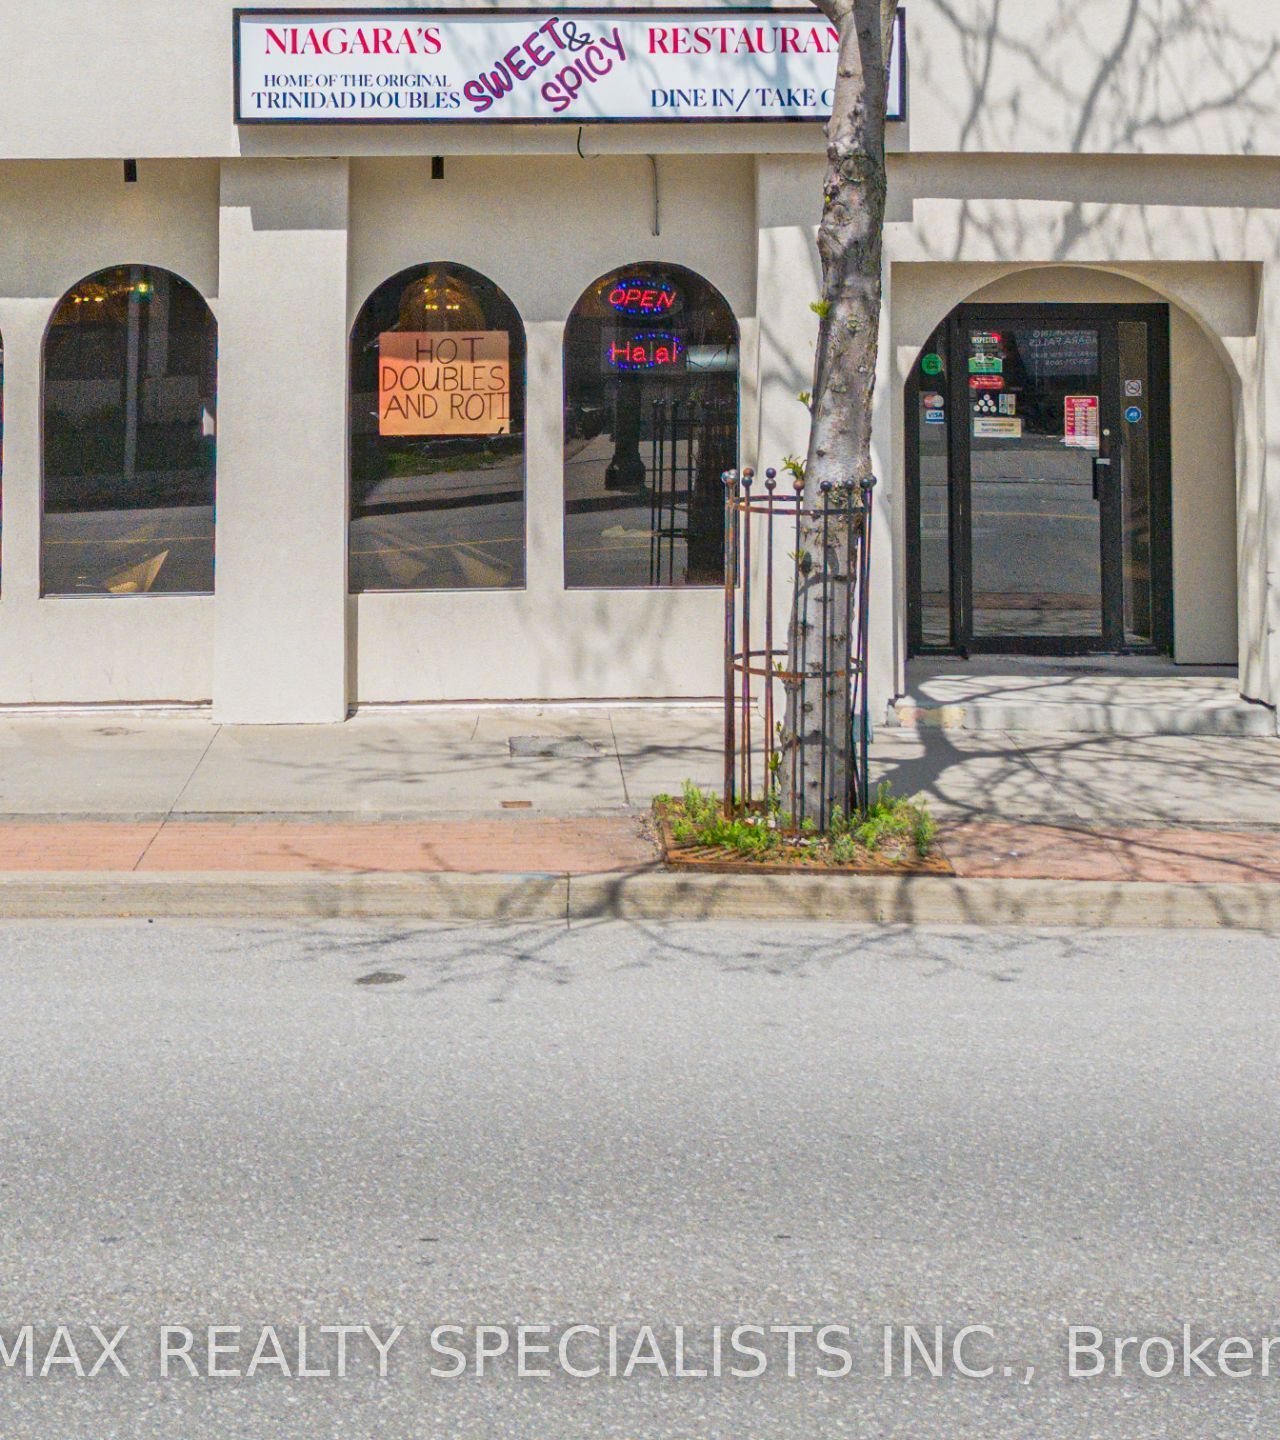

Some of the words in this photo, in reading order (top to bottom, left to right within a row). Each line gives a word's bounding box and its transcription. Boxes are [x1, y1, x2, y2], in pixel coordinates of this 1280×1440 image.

[265, 27, 442, 54] NIAGARA'S
[648, 26, 840, 54] RESTAURAN
[463, 17, 567, 112] SWEET
[562, 21, 595, 52] &
[540, 27, 626, 112] SPICY
[264, 74, 313, 88] HOME
[315, 74, 337, 88] OF
[340, 74, 374, 88] THE
[376, 74, 451, 88] ORIGINAL
[251, 91, 356, 109] TRINIDAD
[360, 91, 461, 109] DOUBLES
[651, 88, 707, 107] DINE
[755, 87, 817, 107] TAKE
[608, 289, 677, 308] OPEN
[416, 337, 484, 364] HOT
[610, 340, 677, 363] Halal
[382, 365, 505, 392] DOUBLES
[384, 393, 438, 420] AND
[450, 392, 509, 420] ROTI
